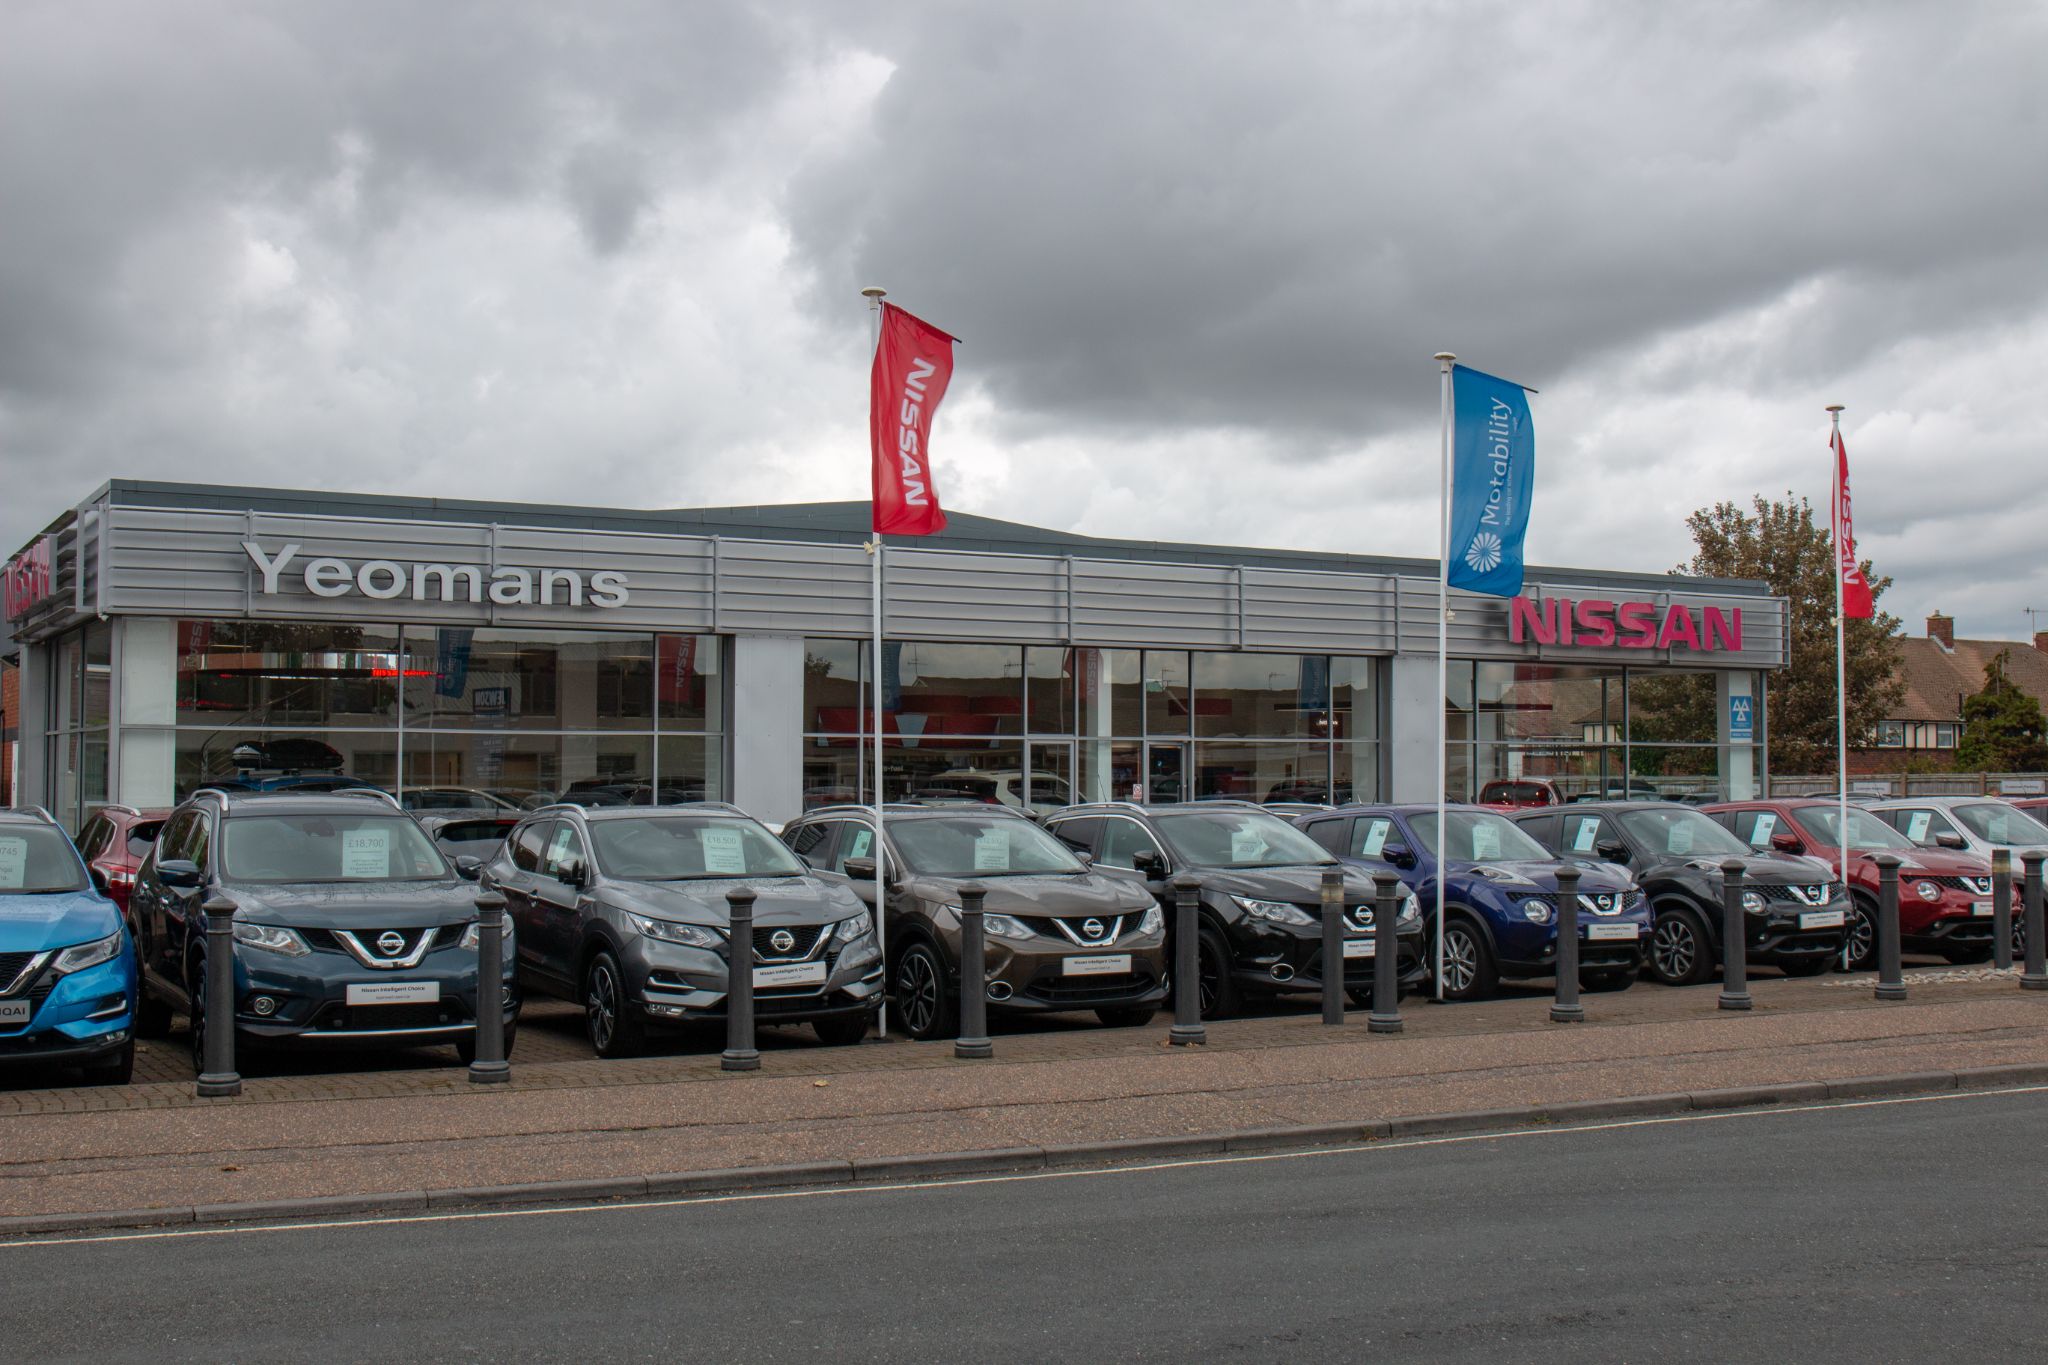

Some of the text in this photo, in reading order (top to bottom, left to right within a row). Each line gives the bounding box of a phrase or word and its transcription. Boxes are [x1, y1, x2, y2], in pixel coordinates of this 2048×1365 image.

[899, 357, 937, 506] NISSAN
[1480, 397, 1512, 525] Motability
[240, 541, 629, 608] Yeomans
[1508, 596, 1742, 652] NISSAN
[348, 838, 384, 849] £18,700
